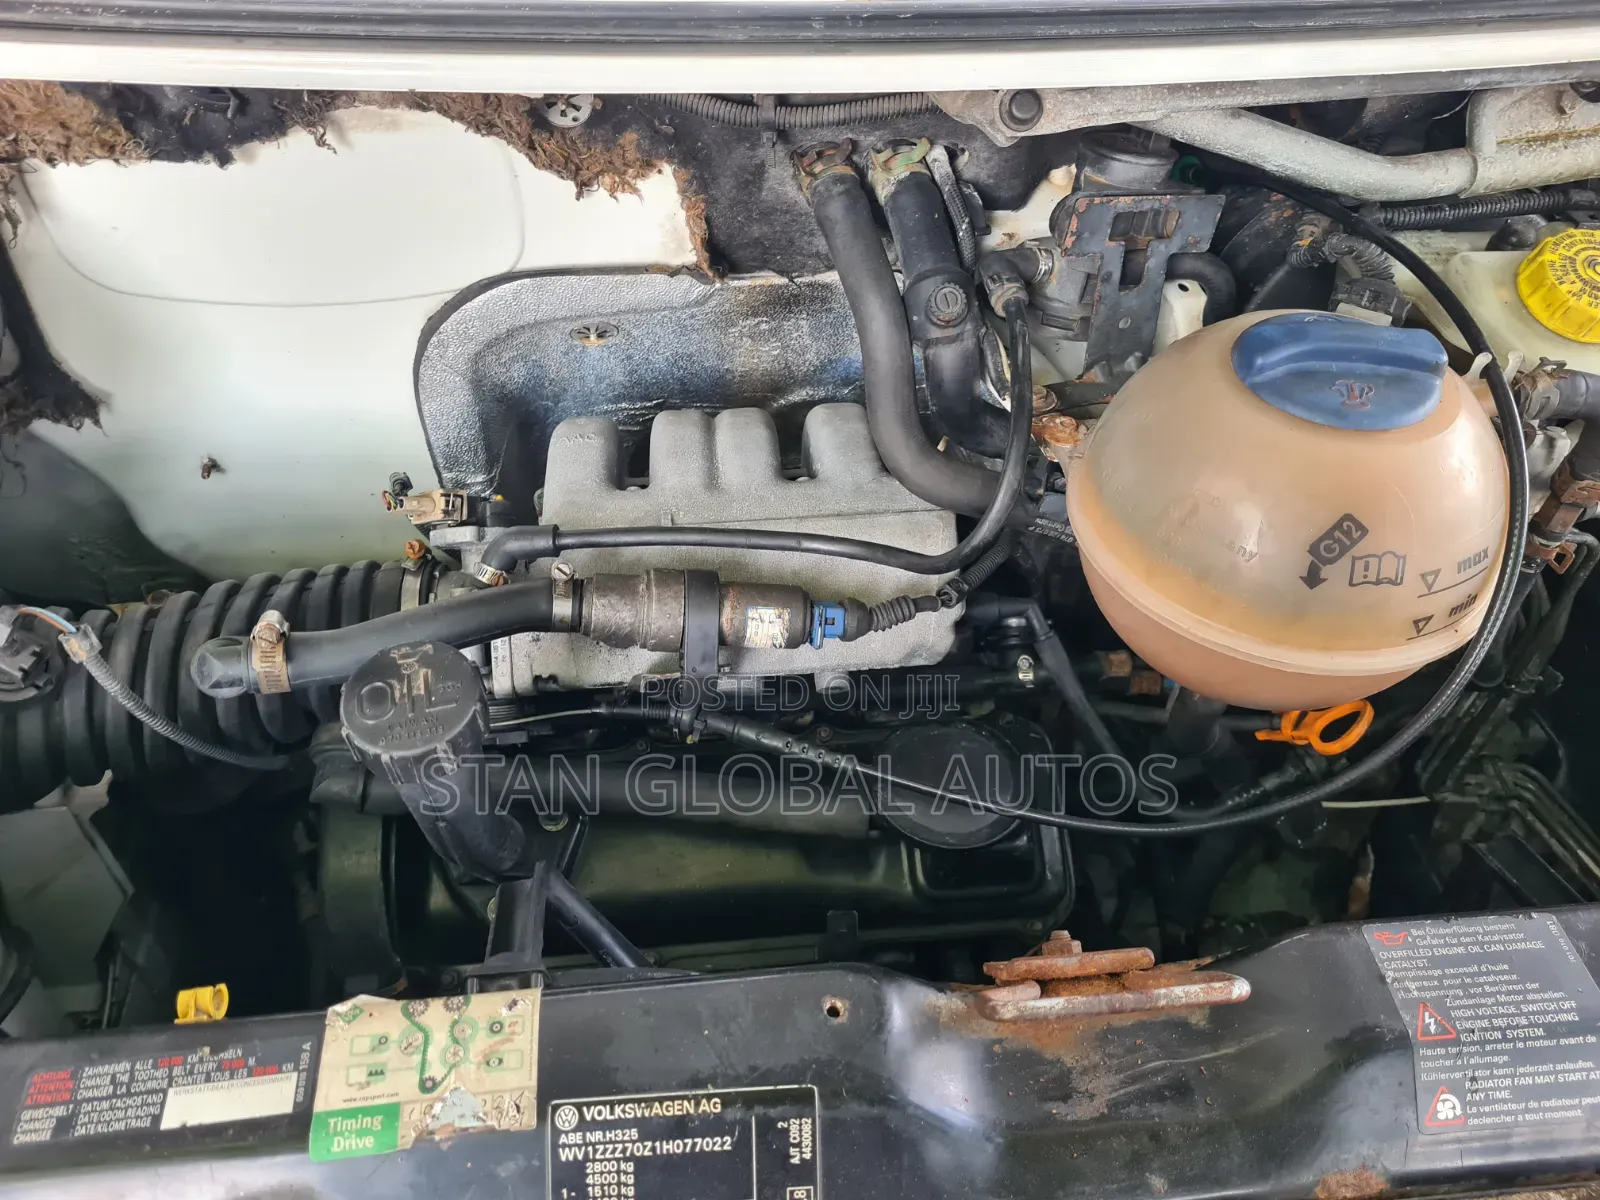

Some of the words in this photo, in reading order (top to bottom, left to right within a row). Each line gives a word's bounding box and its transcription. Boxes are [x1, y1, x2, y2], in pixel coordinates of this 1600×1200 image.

[1318, 520, 1362, 558] G12
[1456, 545, 1490, 574] max
[1448, 593, 1478, 618] min
[355, 668, 457, 724] OIL
[1411, 928, 1425, 936] Bei
[1484, 922, 1516, 932] besteht
[1416, 935, 1445, 946] Gefahr
[1446, 936, 1458, 944] für
[1461, 935, 1476, 943] den
[1477, 932, 1527, 942] Katalysator.
[1379, 948, 1432, 959] OVERFILLED
[1433, 946, 1467, 956] ENGINE
[1468, 945, 1484, 953] OIL
[1484, 943, 1504, 952] CAN
[1505, 941, 1546, 951] DAMAGE
[1383, 959, 1432, 969] CATALYST.
[1444, 964, 1478, 974] excessif
[1480, 963, 1509, 972] d'huile
[1443, 978, 1462, 986] pour
[1464, 976, 1473, 984] le
[1474, 973, 1520, 983] catalyseur.
[1484, 982, 1525, 993] Berühren
[1526, 982, 1540, 990] der
[1445, 996, 1496, 1007] Zündanlage
[1497, 994, 1524, 1003] Motor
[1526, 990, 1568, 1000] abstellen.
[1450, 1009, 1475, 1018] HIGH
[1520, 1002, 1559, 1012] SWITCH
[1559, 1000, 1577, 1009] OFF
[1455, 1019, 1491, 1030] ENGINE
[1492, 1016, 1529, 1027] BEFORE
[1528, 1012, 1580, 1024] TOUCHING
[1460, 1030, 1503, 1042] IGNITION
[1506, 1027, 1547, 1038] SYSTEM.
[302, 1041, 312, 1051] A
[1419, 1047, 1446, 1056] Haute
[1484, 1042, 1514, 1051] arreter
[1515, 1040, 1524, 1049] le
[1526, 1038, 1558, 1048] moteur
[1559, 1035, 1585, 1045] avant
[1585, 1034, 1597, 1043] de
[83, 1061, 131, 1077] ZAHNRIEMEN
[134, 1059, 153, 1071] ALLE
[1420, 1059, 1454, 1068] toucher
[1464, 1055, 1511, 1065] l'allumage.
[1493, 1066, 1516, 1076] kann
[1516, 1063, 1554, 1076] jederzeit
[1555, 1060, 1596, 1071] anlaufen.
[24, 1091, 72, 1106] ATTENTION
[77, 1085, 113, 1100] CHANGER
[116, 1085, 127, 1094] LA
[131, 1078, 169, 1093] COURROIE
[210, 1070, 231, 1082] TOUS
[233, 1068, 248, 1079] LES
[282, 1062, 295, 1073] KM
[28, 1080, 75, 1094] ATTENTION
[80, 1074, 112, 1088] CHANGE
[115, 1072, 130, 1083] THE
[134, 1068, 169, 1080] TOOTHED
[172, 1064, 191, 1077] BELT
[194, 1061, 219, 1074] EVERY
[1465, 1078, 1512, 1090] RADIATOR
[1514, 1076, 1533, 1086] FAN
[1534, 1074, 1556, 1084] MAY
[1557, 1071, 1588, 1082] START
[1589, 1070, 1600, 1080] AT
[1465, 1091, 1487, 1102] ANY
[1487, 1090, 1513, 1100] TIME.
[582, 1099, 695, 1121] VOLKSWAGEN
[698, 1097, 722, 1114] AG
[1466, 1105, 1478, 1114] Le
[1479, 1102, 1526, 1113] ventilateur
[1527, 1099, 1539, 1109] de
[1540, 1097, 1581, 1108] radiateur
[17, 1117, 57, 1132] CHANGED
[328, 1114, 384, 1134] Timing
[777, 1121, 788, 1129] 2
[1467, 1114, 1516, 1126] declencher
[1525, 1111, 1544, 1121] tout
[1545, 1108, 1584, 1119] moment.
[332, 1133, 375, 1152] Drive
[558, 1131, 583, 1145] ABE
[801, 1117, 813, 1160] 4430082
[558, 1136, 732, 1162] WV1ZZZ70Z1H077022
[585, 1160, 618, 1174] 2800
[620, 1159, 635, 1173] kg
[585, 1172, 618, 1185] 4500
[620, 1172, 635, 1185] kg
[587, 1185, 618, 1198] 1510
[621, 1184, 635, 1197] kg
